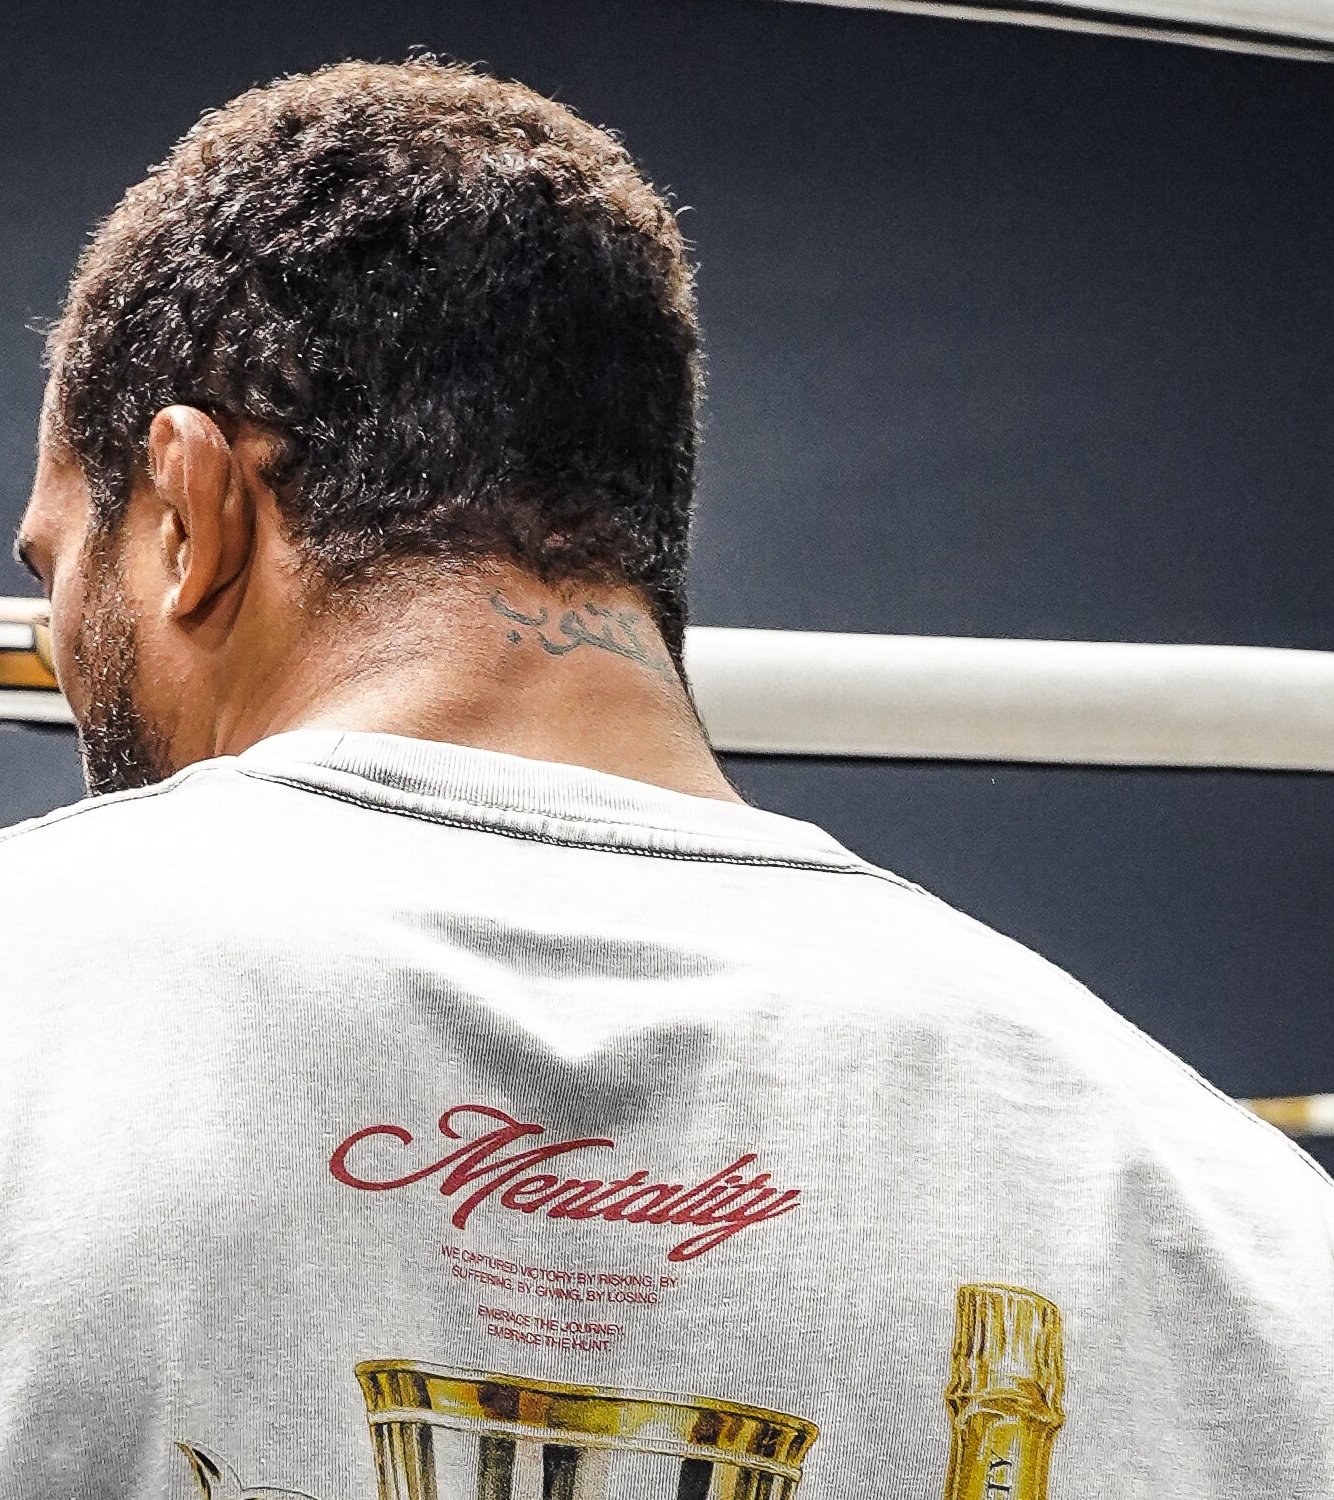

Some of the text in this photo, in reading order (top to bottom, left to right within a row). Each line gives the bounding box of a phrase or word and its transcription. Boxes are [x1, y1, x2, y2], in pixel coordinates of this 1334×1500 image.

[329, 1104, 801, 1262] Mentality
[441, 1244, 460, 1259] WE
[461, 1249, 518, 1274] CAPTURED
[520, 1265, 575, 1283] VICTORY
[577, 1272, 595, 1285] BY
[659, 1275, 677, 1288] BY
[517, 1280, 533, 1294] BY
[586, 1288, 605, 1302] BY
[478, 1304, 531, 1327] EMBRACE
[534, 1316, 559, 1332] THE
[488, 1323, 542, 1346] EMBRACE
[545, 1335, 571, 1350] THE
